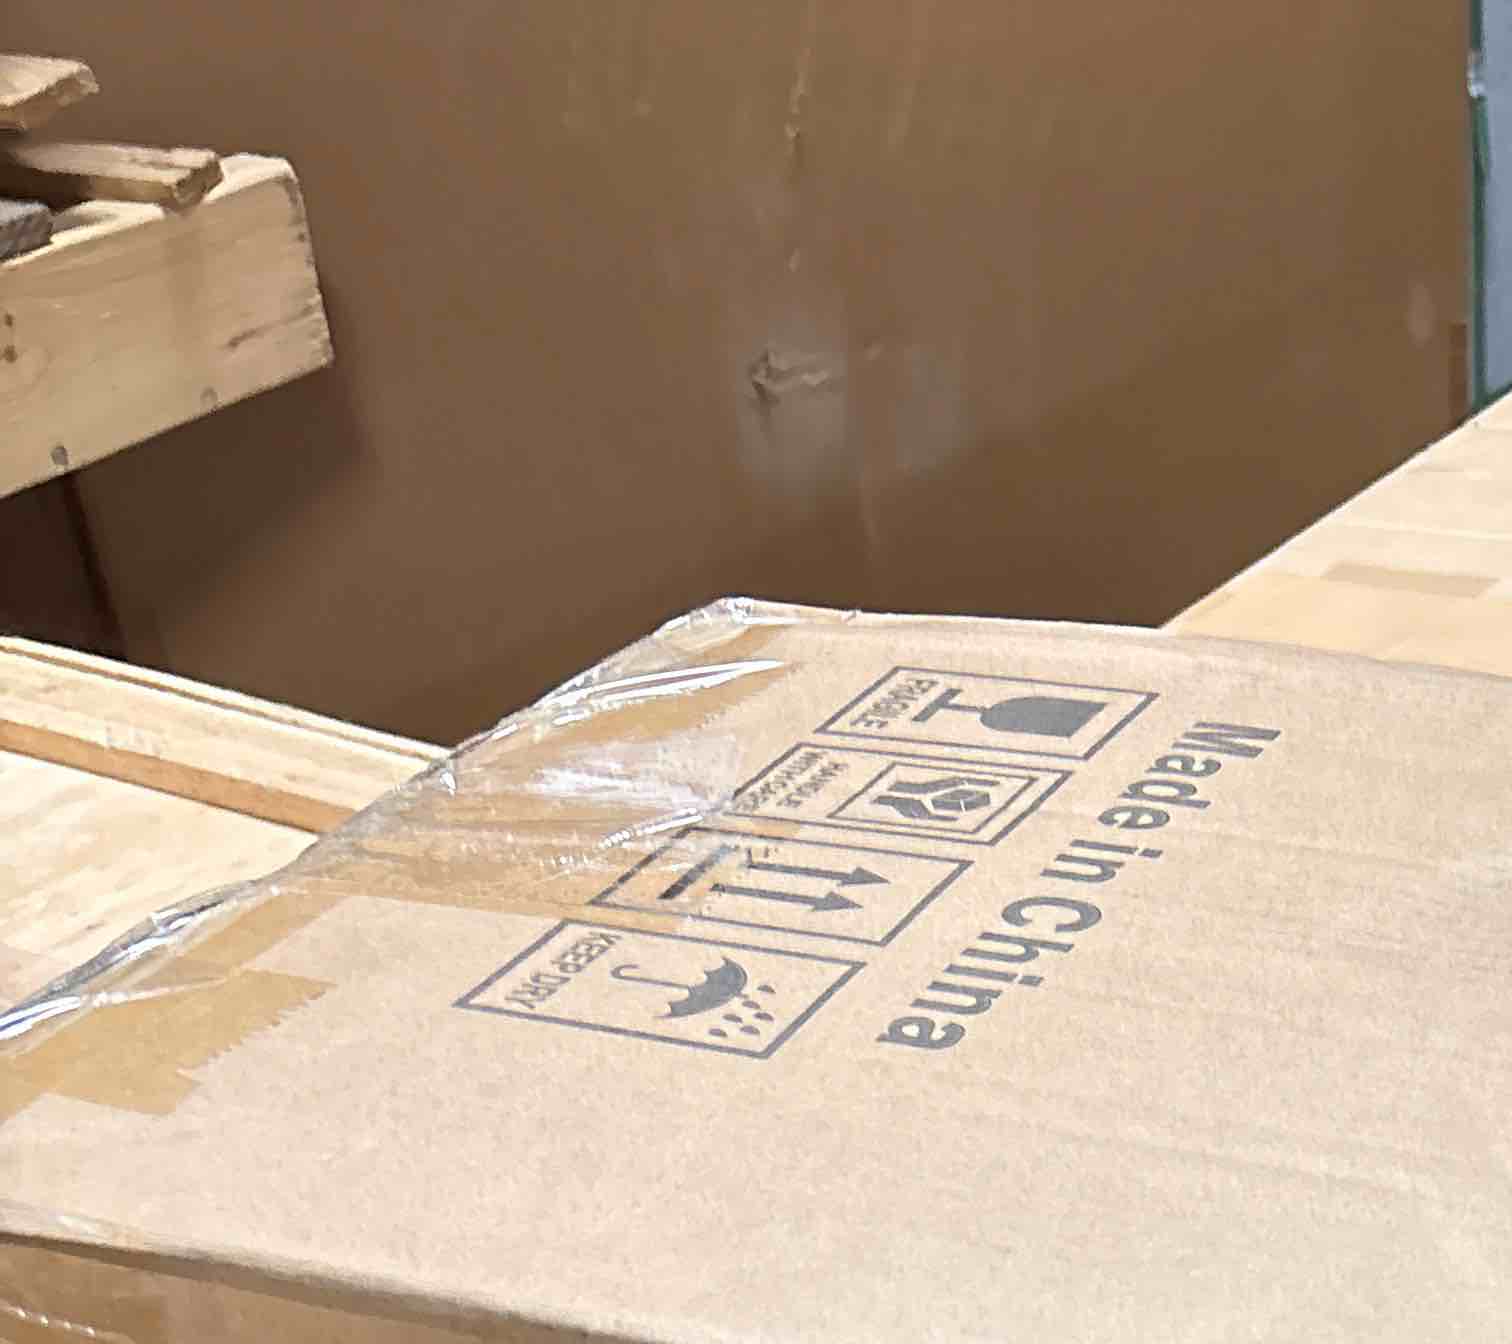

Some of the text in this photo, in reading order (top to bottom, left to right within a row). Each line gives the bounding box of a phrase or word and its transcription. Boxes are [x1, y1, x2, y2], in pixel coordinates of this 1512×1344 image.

[876, 721, 1282, 1050] Made in China
